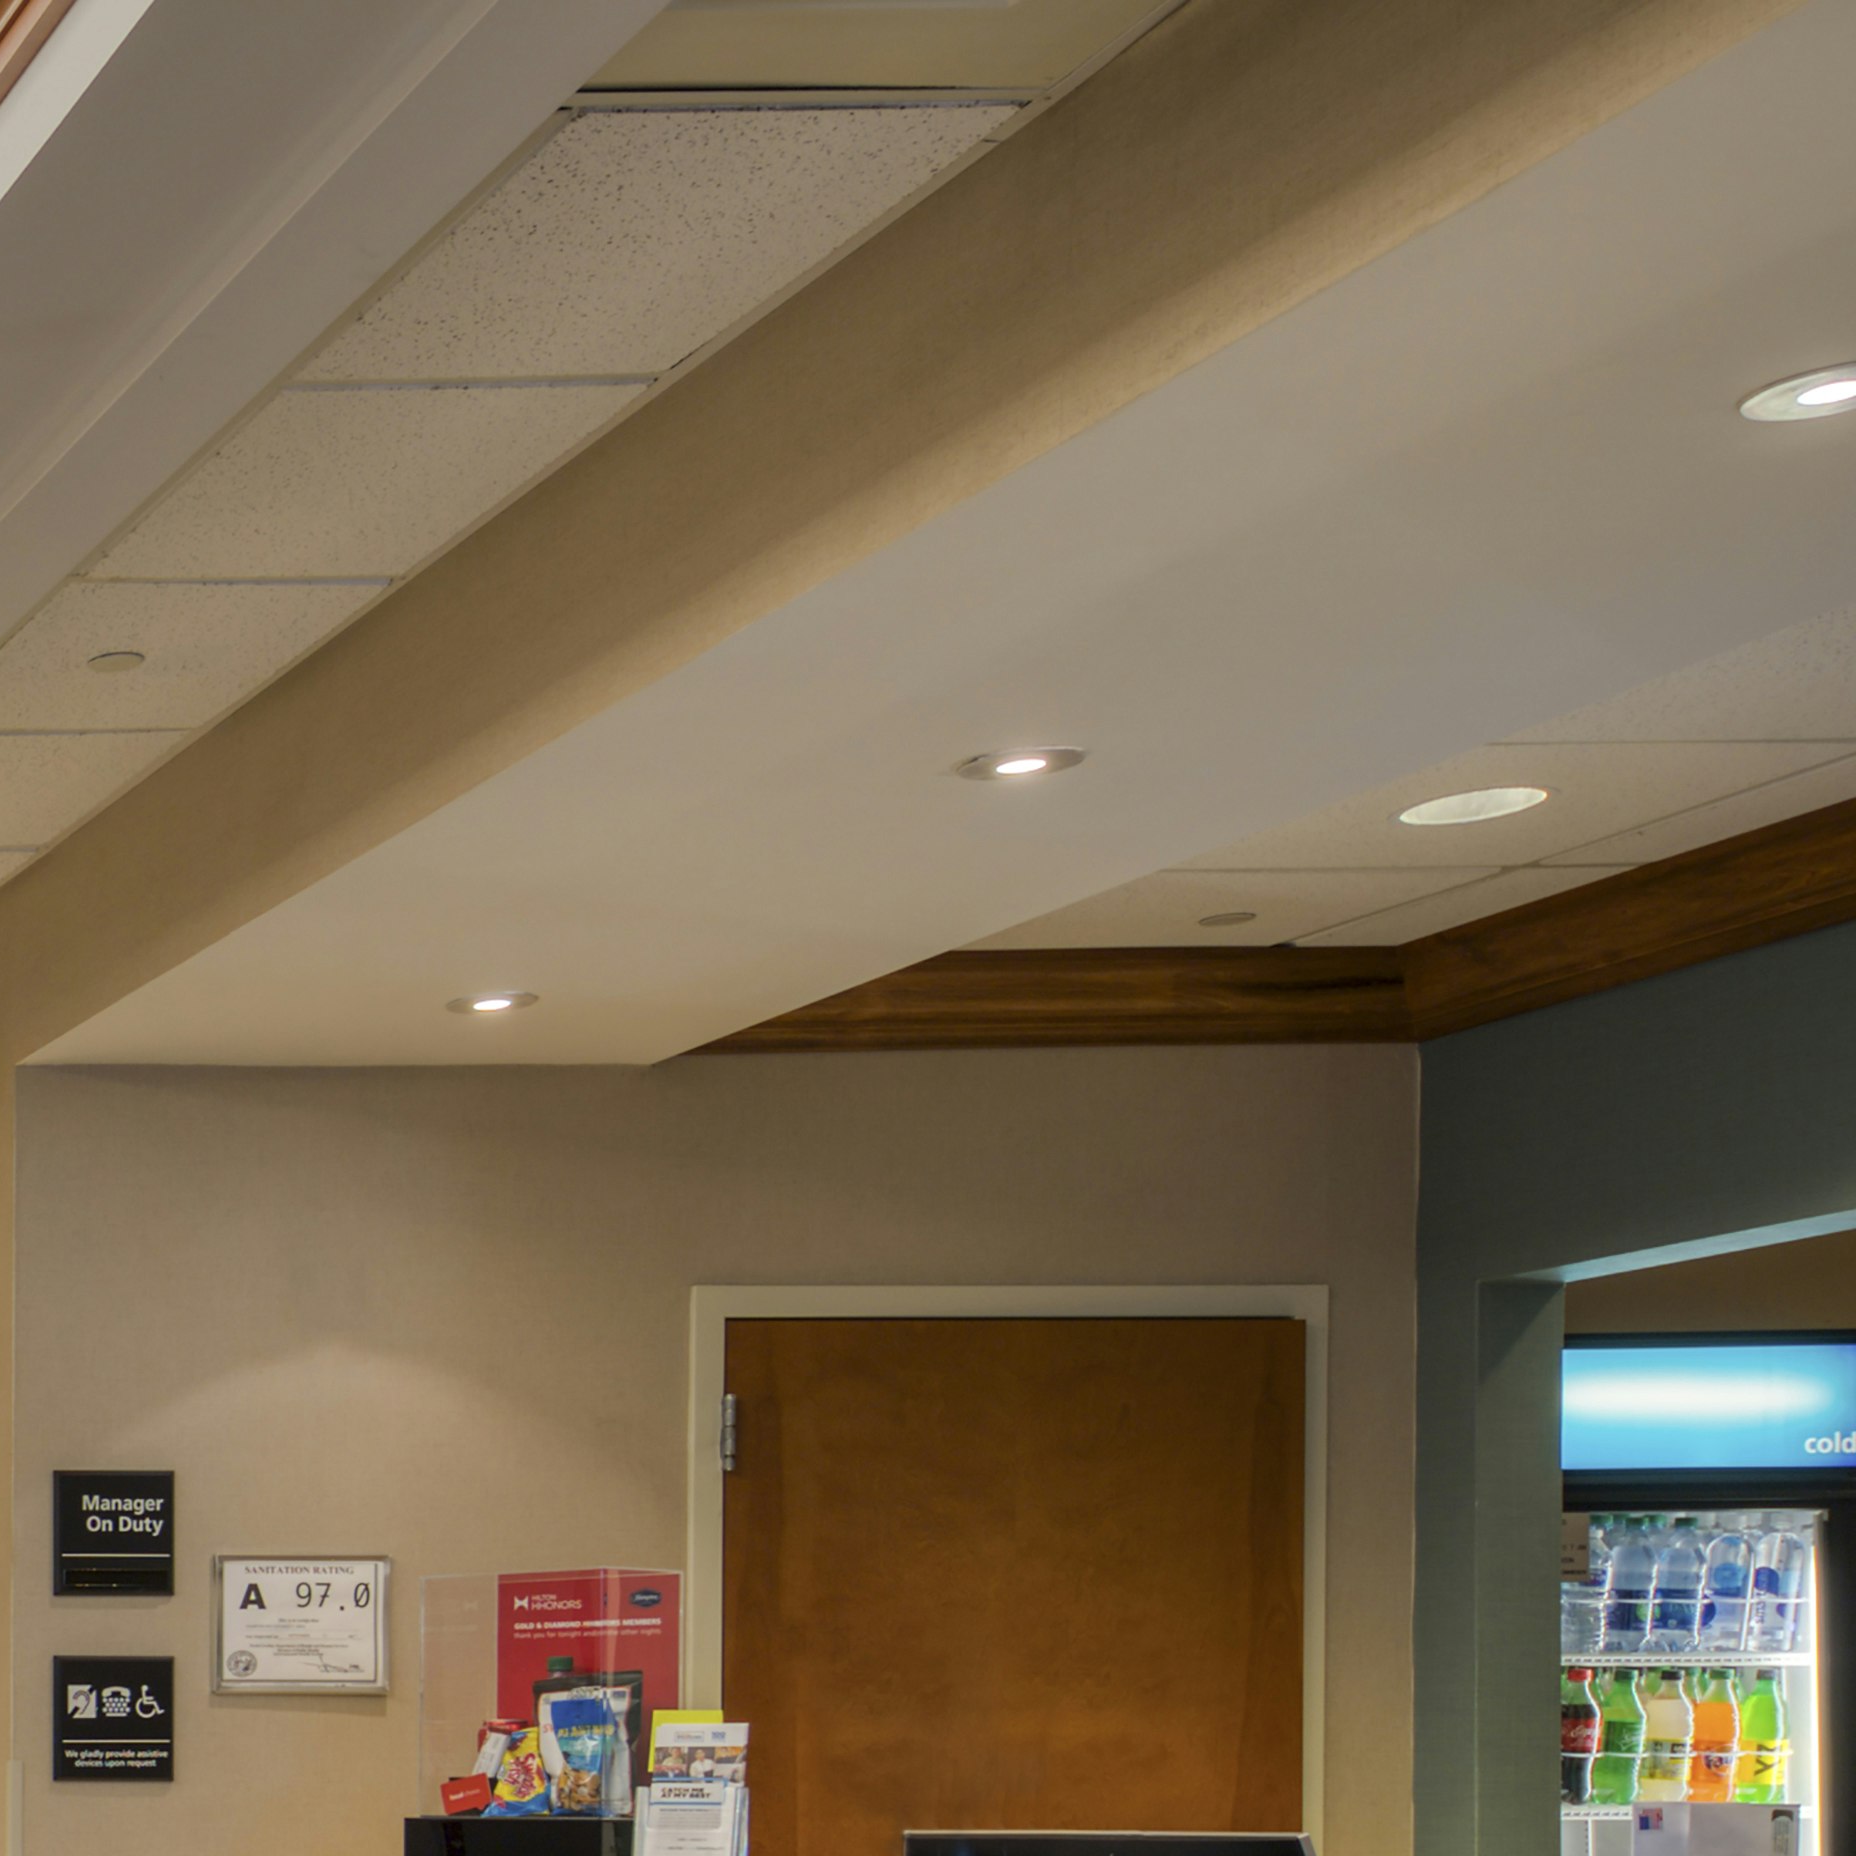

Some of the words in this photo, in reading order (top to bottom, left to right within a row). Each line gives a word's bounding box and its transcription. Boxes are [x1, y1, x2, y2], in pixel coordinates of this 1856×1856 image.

[1804, 1431, 1856, 1454] cold
[81, 1495, 164, 1514] Manager
[86, 1516, 113, 1532] On
[118, 1516, 164, 1536] Duty
[245, 1566, 311, 1575] SANITATION
[313, 1566, 355, 1575] RATING
[239, 1583, 267, 1610] A
